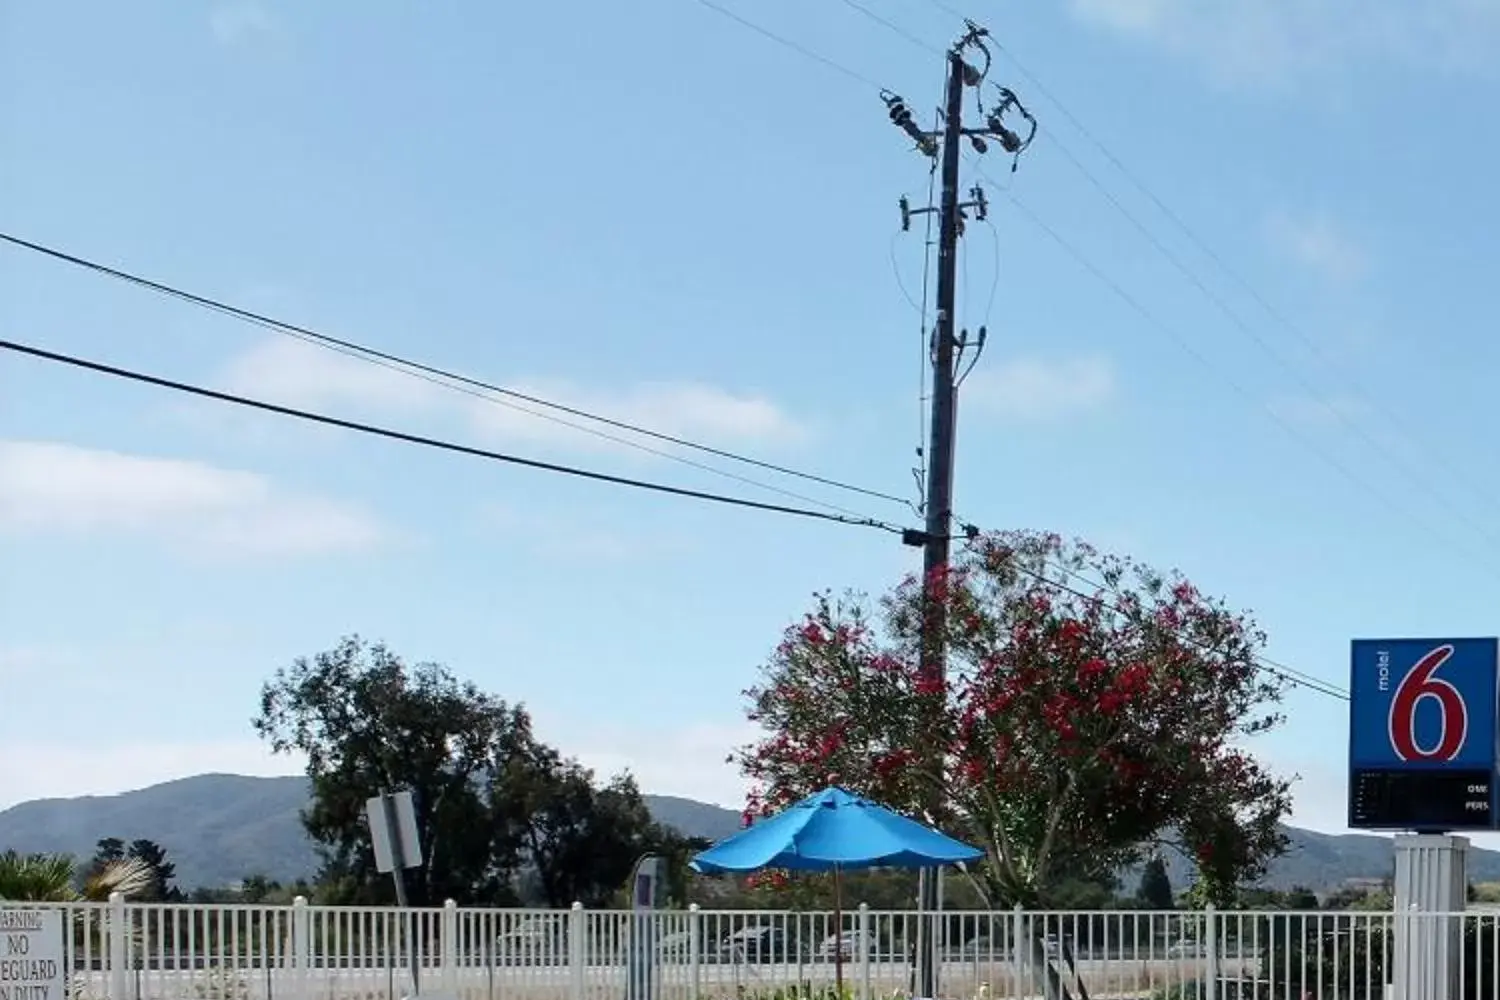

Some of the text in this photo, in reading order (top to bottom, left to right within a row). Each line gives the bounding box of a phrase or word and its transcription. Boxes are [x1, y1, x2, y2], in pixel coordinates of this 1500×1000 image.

[1377, 644, 1468, 761] motel 6
[0, 911, 42, 929] ARNING
[7, 934, 30, 955] NO
[0, 959, 57, 981] EGUARD
